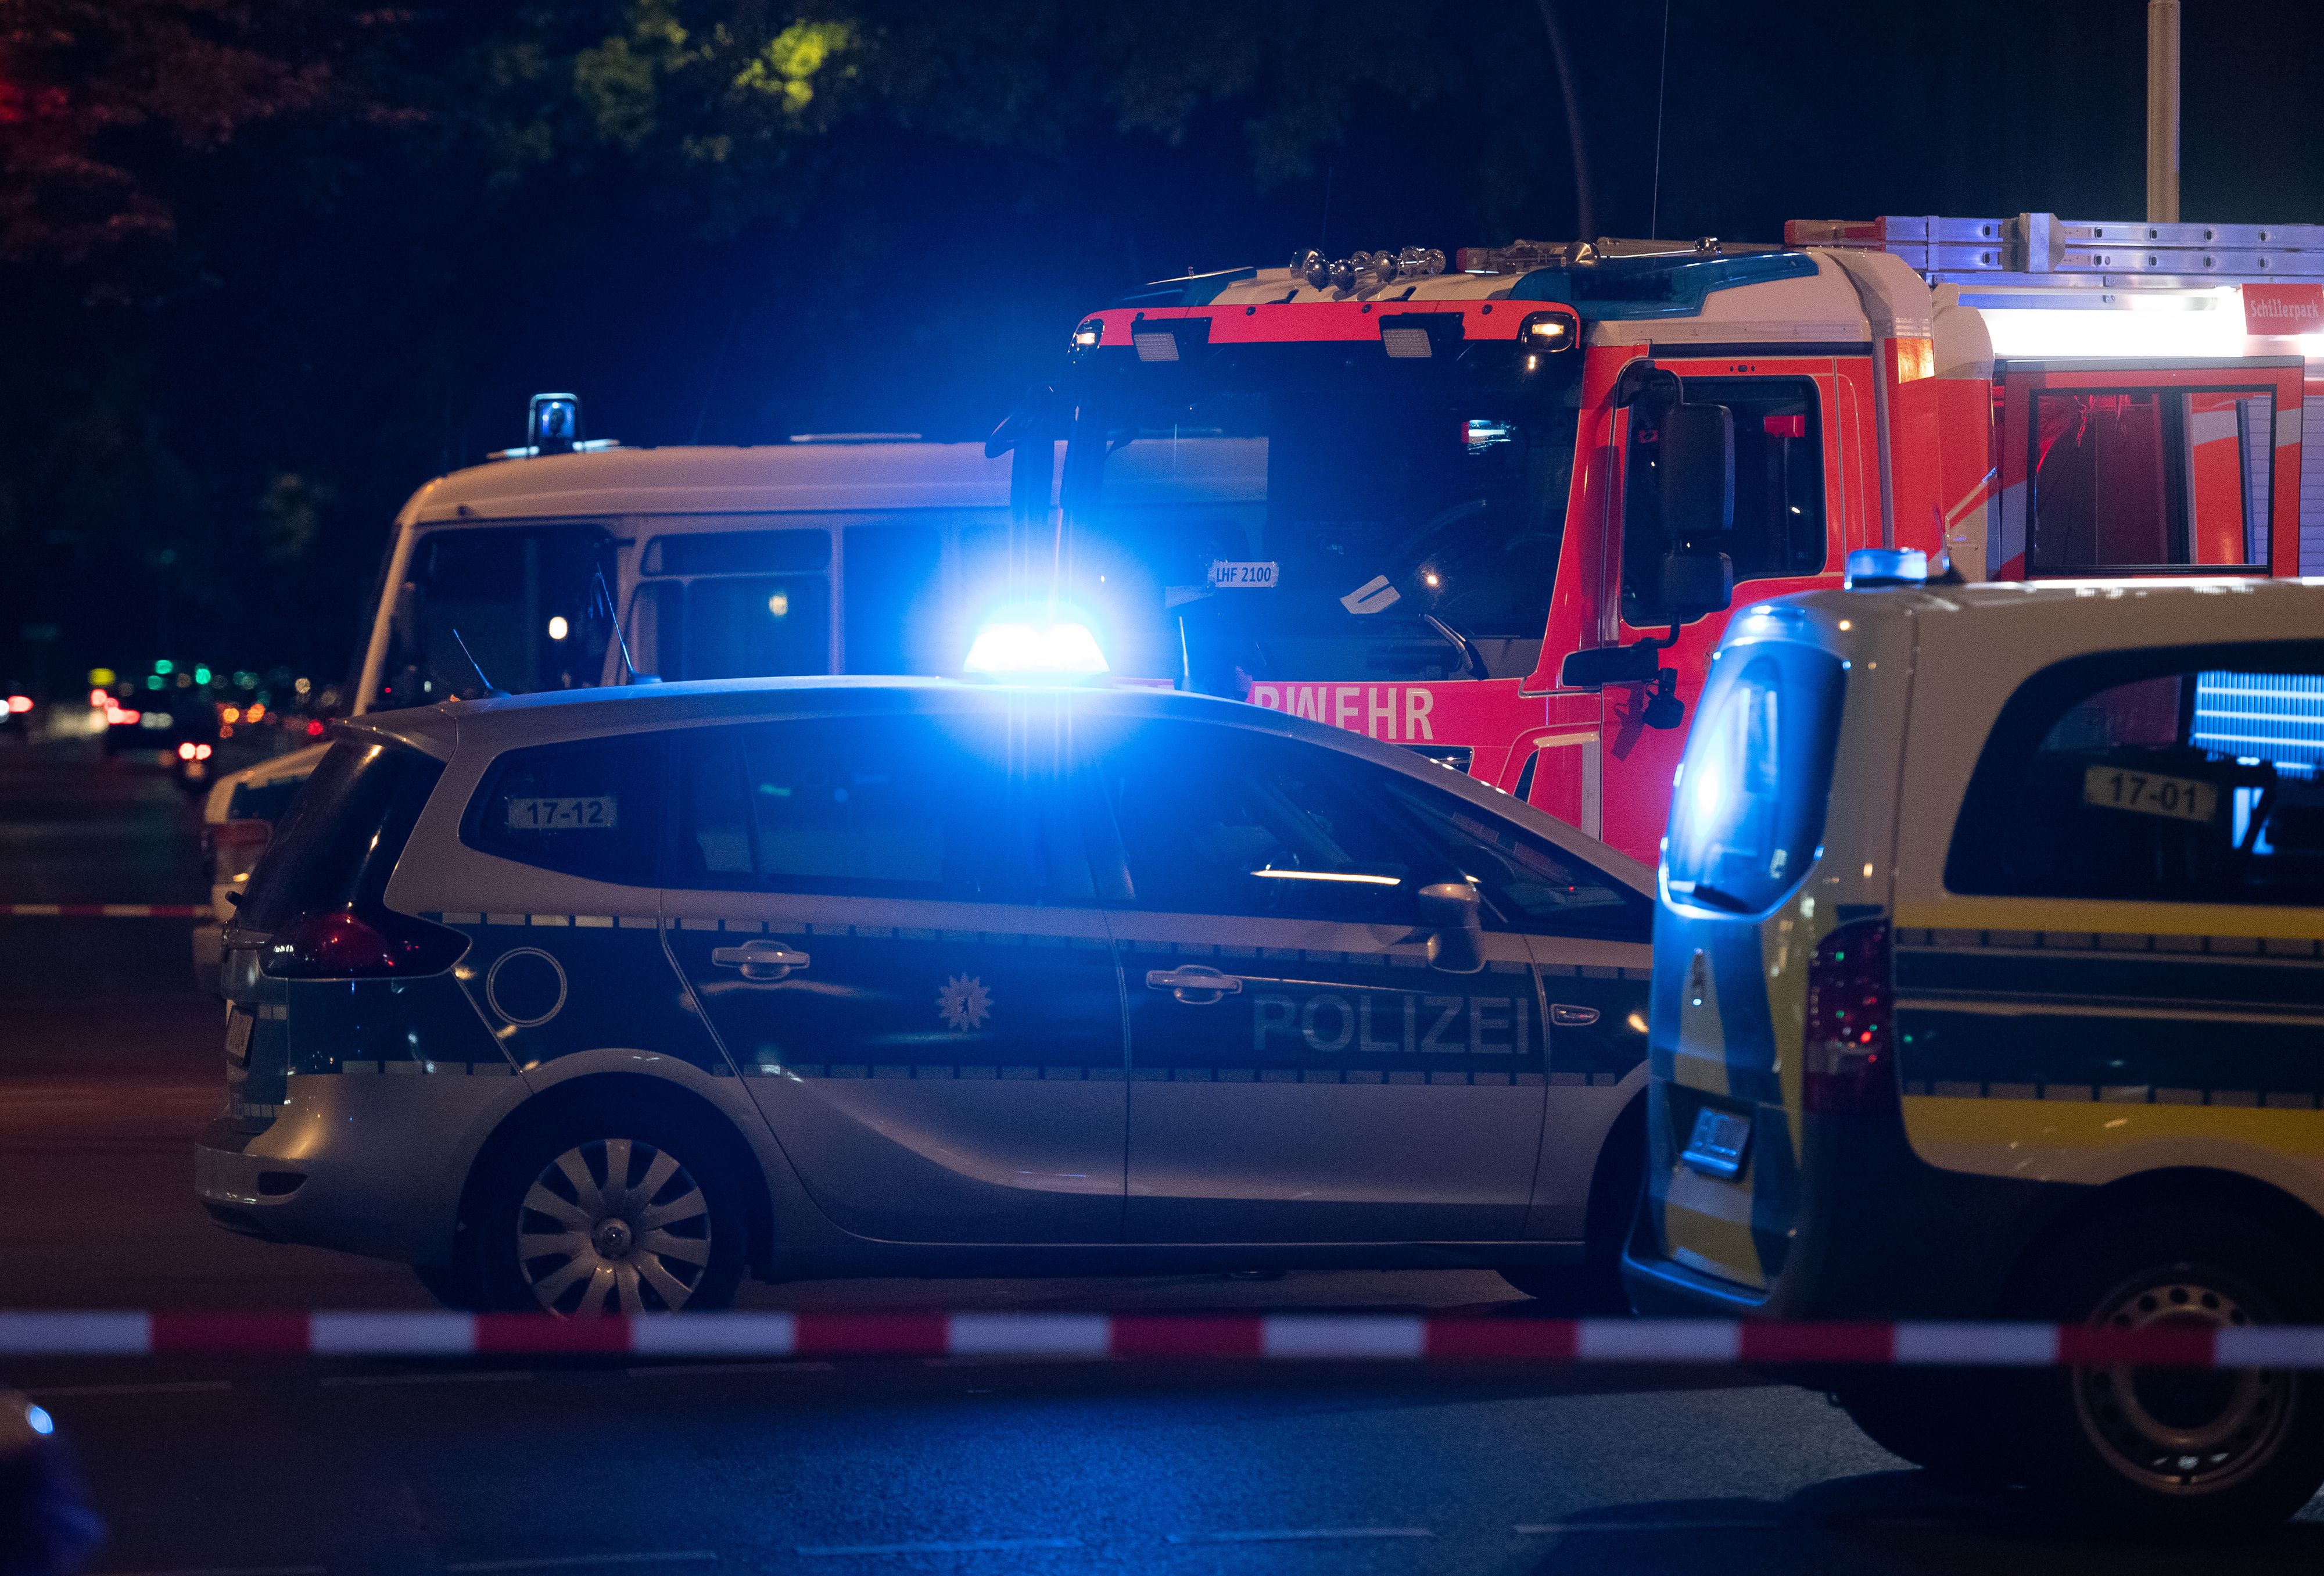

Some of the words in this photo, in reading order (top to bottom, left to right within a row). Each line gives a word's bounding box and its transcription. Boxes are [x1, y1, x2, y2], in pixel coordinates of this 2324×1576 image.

[2250, 299, 2319, 320] Schillerpark
[1216, 567, 1238, 582] LHF
[1241, 567, 1271, 582] 2100
[2111, 774, 2196, 814] 17-01
[527, 801, 604, 824] 17-12
[1253, 994, 1529, 1054] POLIZEI
